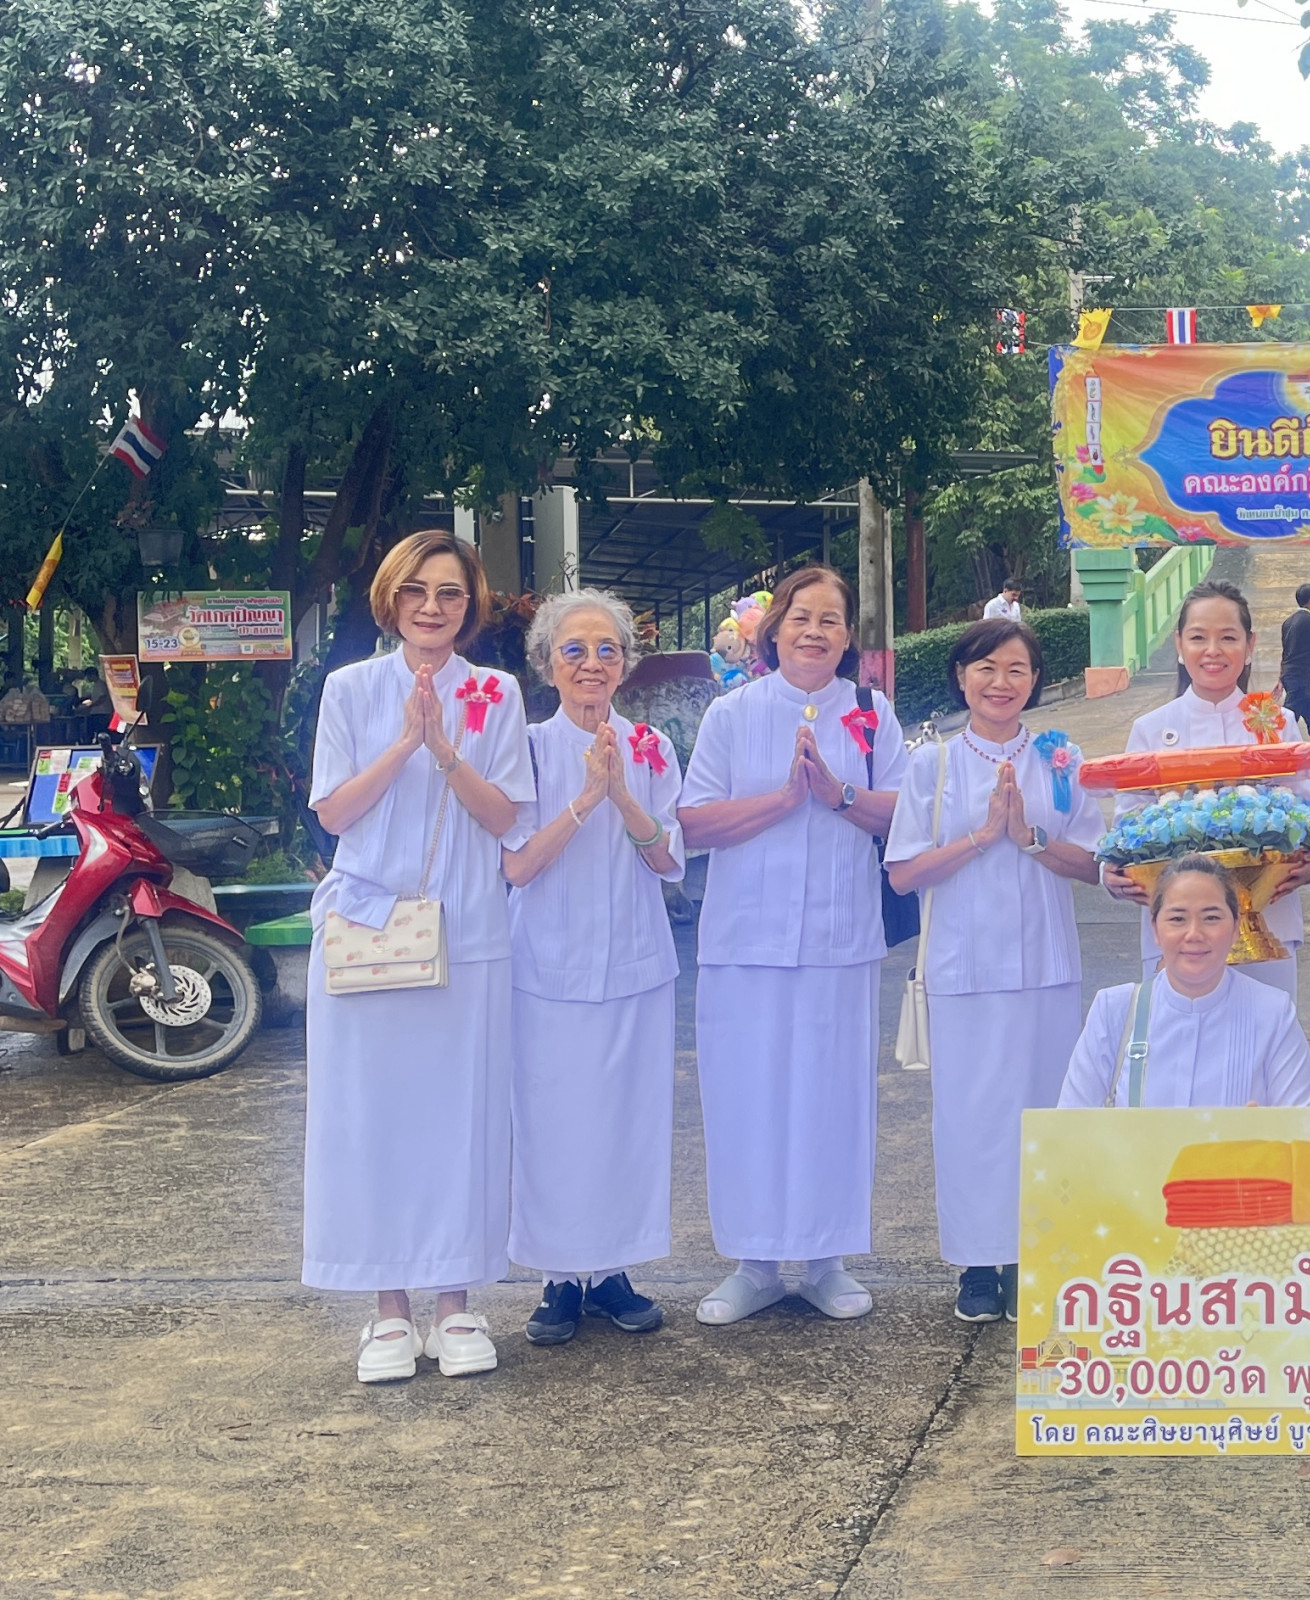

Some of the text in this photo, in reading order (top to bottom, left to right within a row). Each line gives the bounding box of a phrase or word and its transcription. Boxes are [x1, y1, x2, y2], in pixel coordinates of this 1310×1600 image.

[145, 638, 178, 649] 15-23
[1060, 1350, 1266, 1403] 30,000วัด
[1032, 1416, 1075, 1442] โดย
[1087, 1415, 1280, 1449] คณะศิษยานุศิษย์
